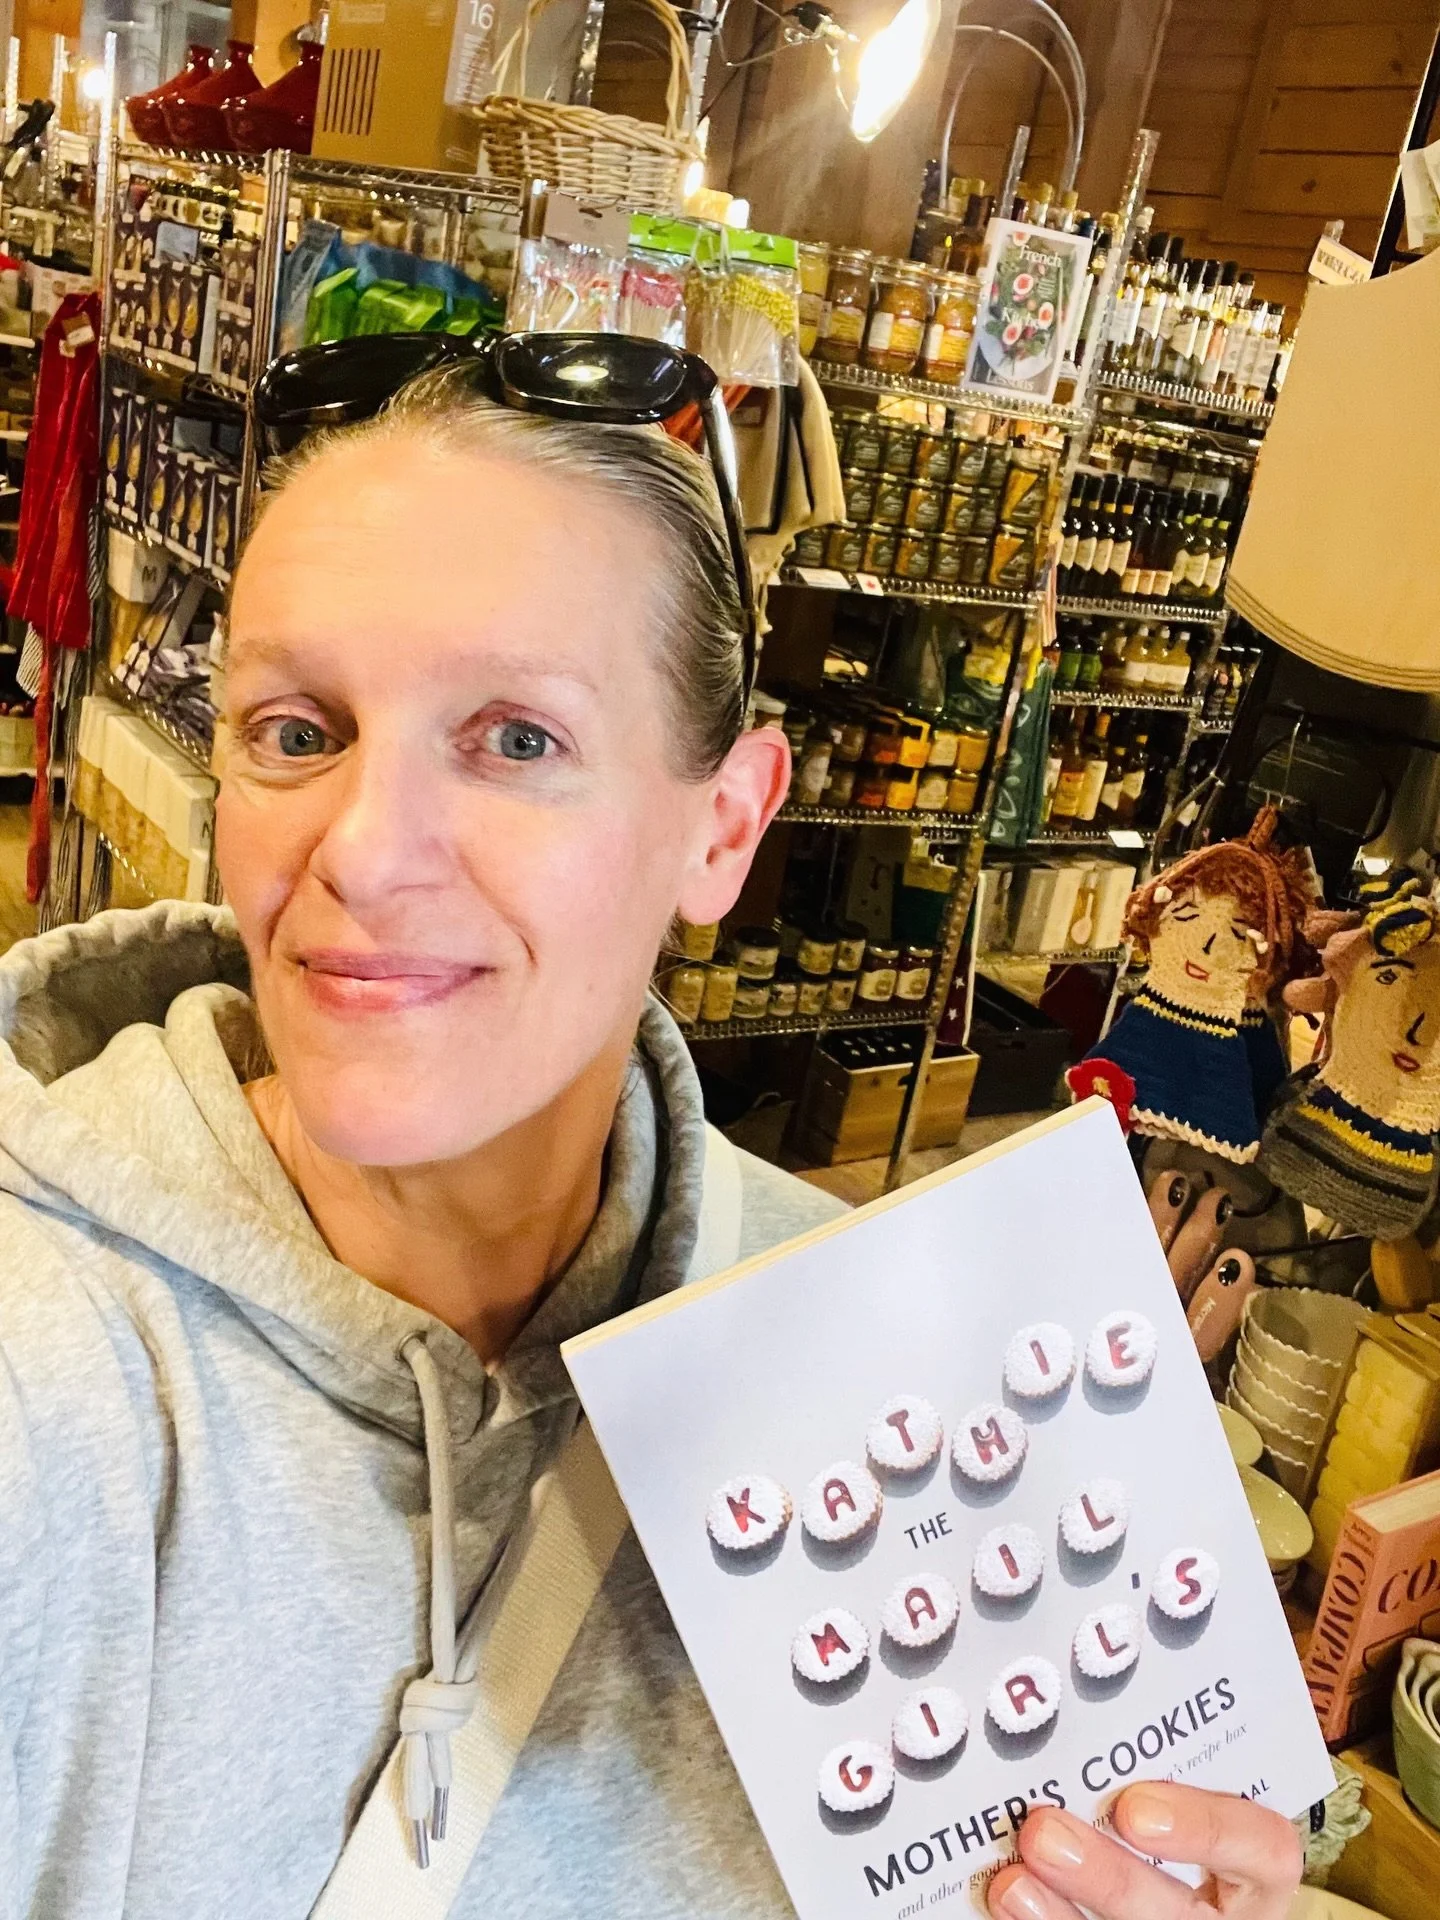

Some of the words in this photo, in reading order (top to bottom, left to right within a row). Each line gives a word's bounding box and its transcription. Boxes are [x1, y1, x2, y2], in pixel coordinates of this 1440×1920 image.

[1019, 244, 1062, 268] French
[727, 1321, 1137, 1534] KATHIE
[811, 1493, 1115, 1667] MAIL
[904, 1512, 953, 1550] THE
[838, 1557, 1203, 1794] GIRL'S
[863, 1779, 1066, 1898] MOTHER'S
[1081, 1677, 1236, 1793] COOKIES
[897, 1893, 925, 1920] and
[929, 1879, 965, 1904] other
[968, 1858, 1002, 1890] good
[1187, 1741, 1222, 1770] recipe
[1226, 1723, 1247, 1745] box
